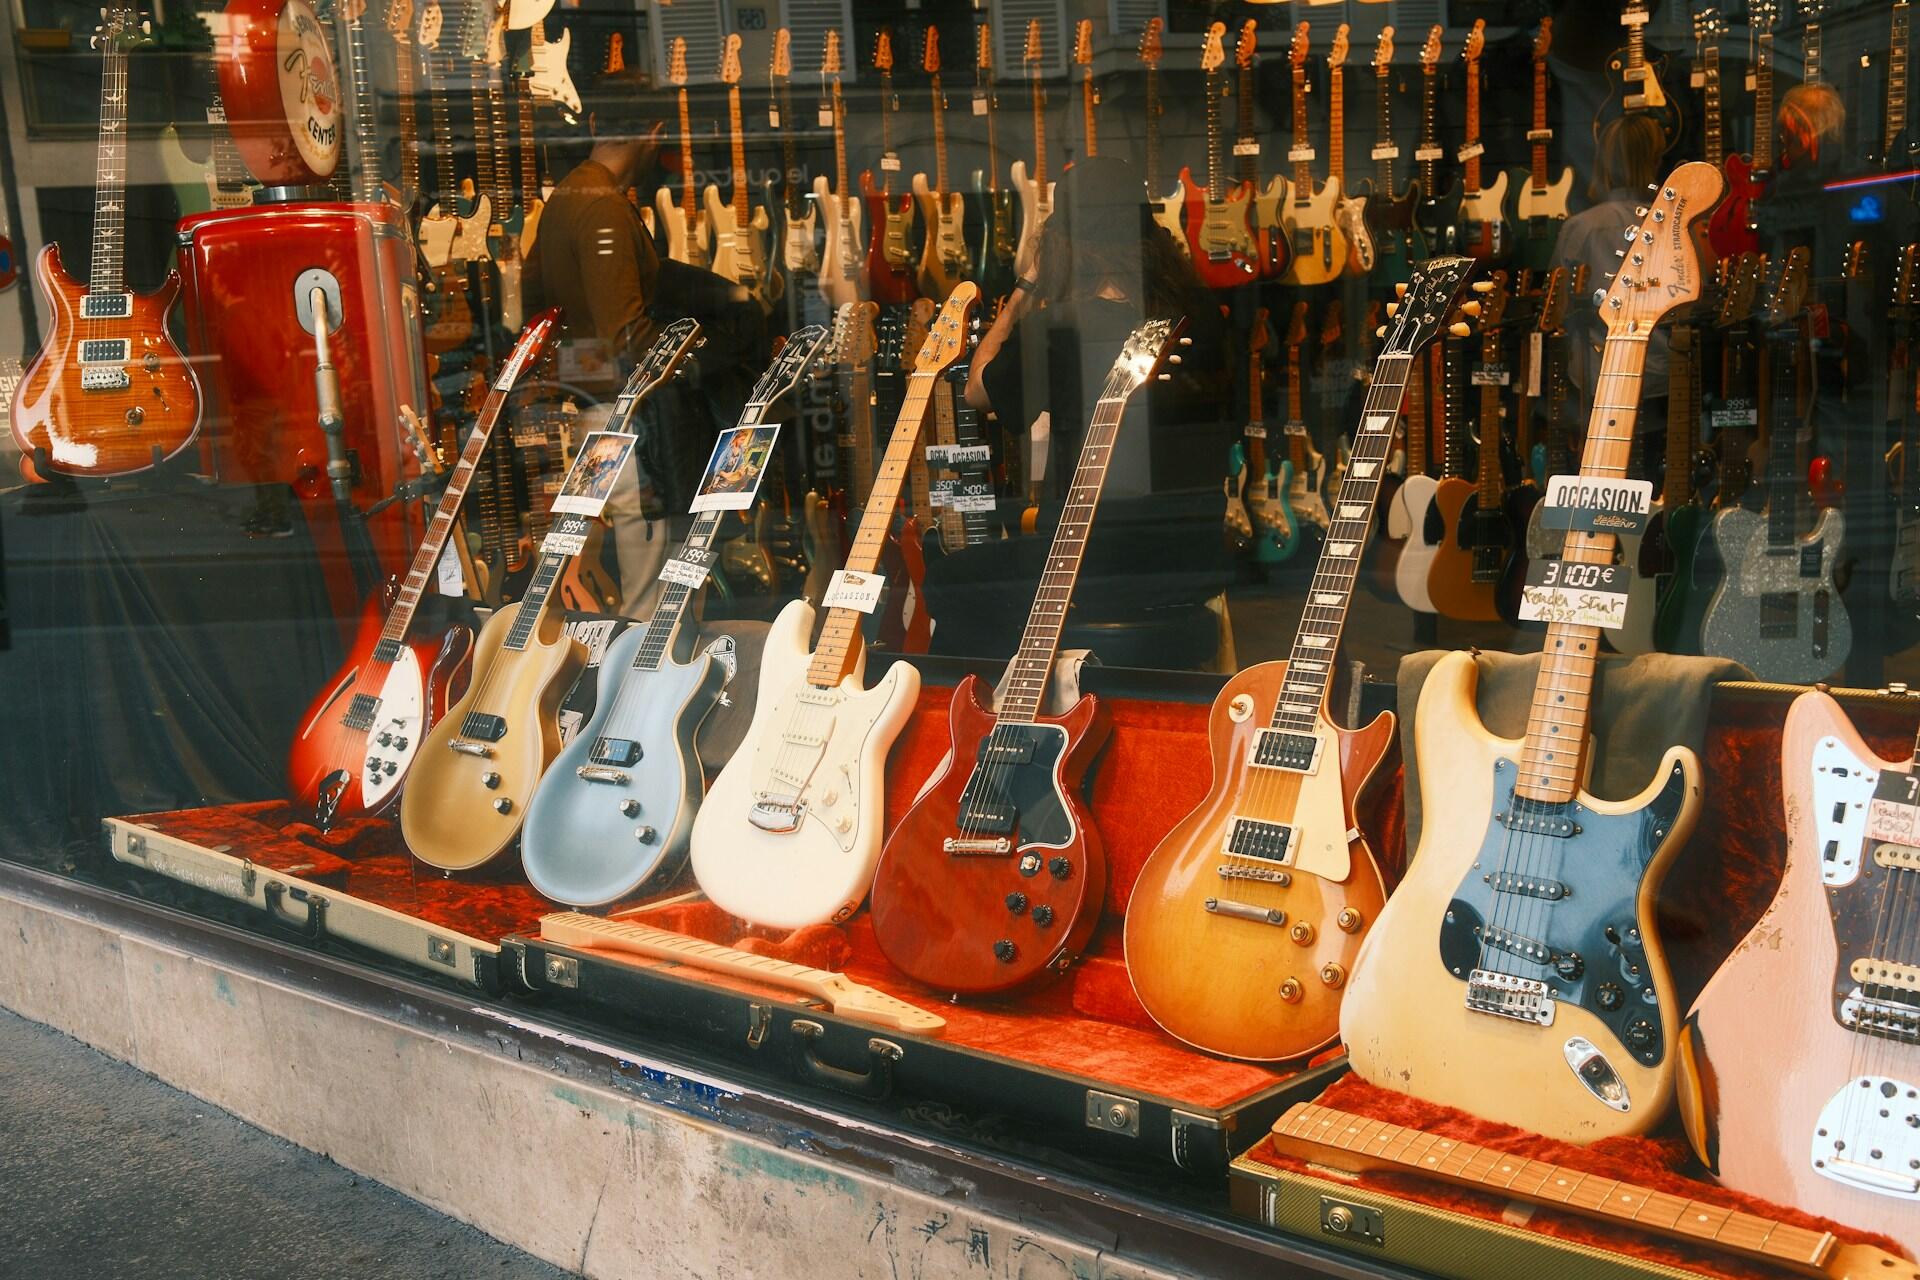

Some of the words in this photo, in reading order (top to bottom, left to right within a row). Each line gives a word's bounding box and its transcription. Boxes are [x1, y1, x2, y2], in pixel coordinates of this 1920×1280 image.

[1673, 198, 1687, 250] STRATOCASTER
[1427, 258, 1460, 274] Gibson
[1667, 255, 1691, 298] Fender
[952, 449, 987, 464] OCCASION
[561, 520, 587, 534] 999€
